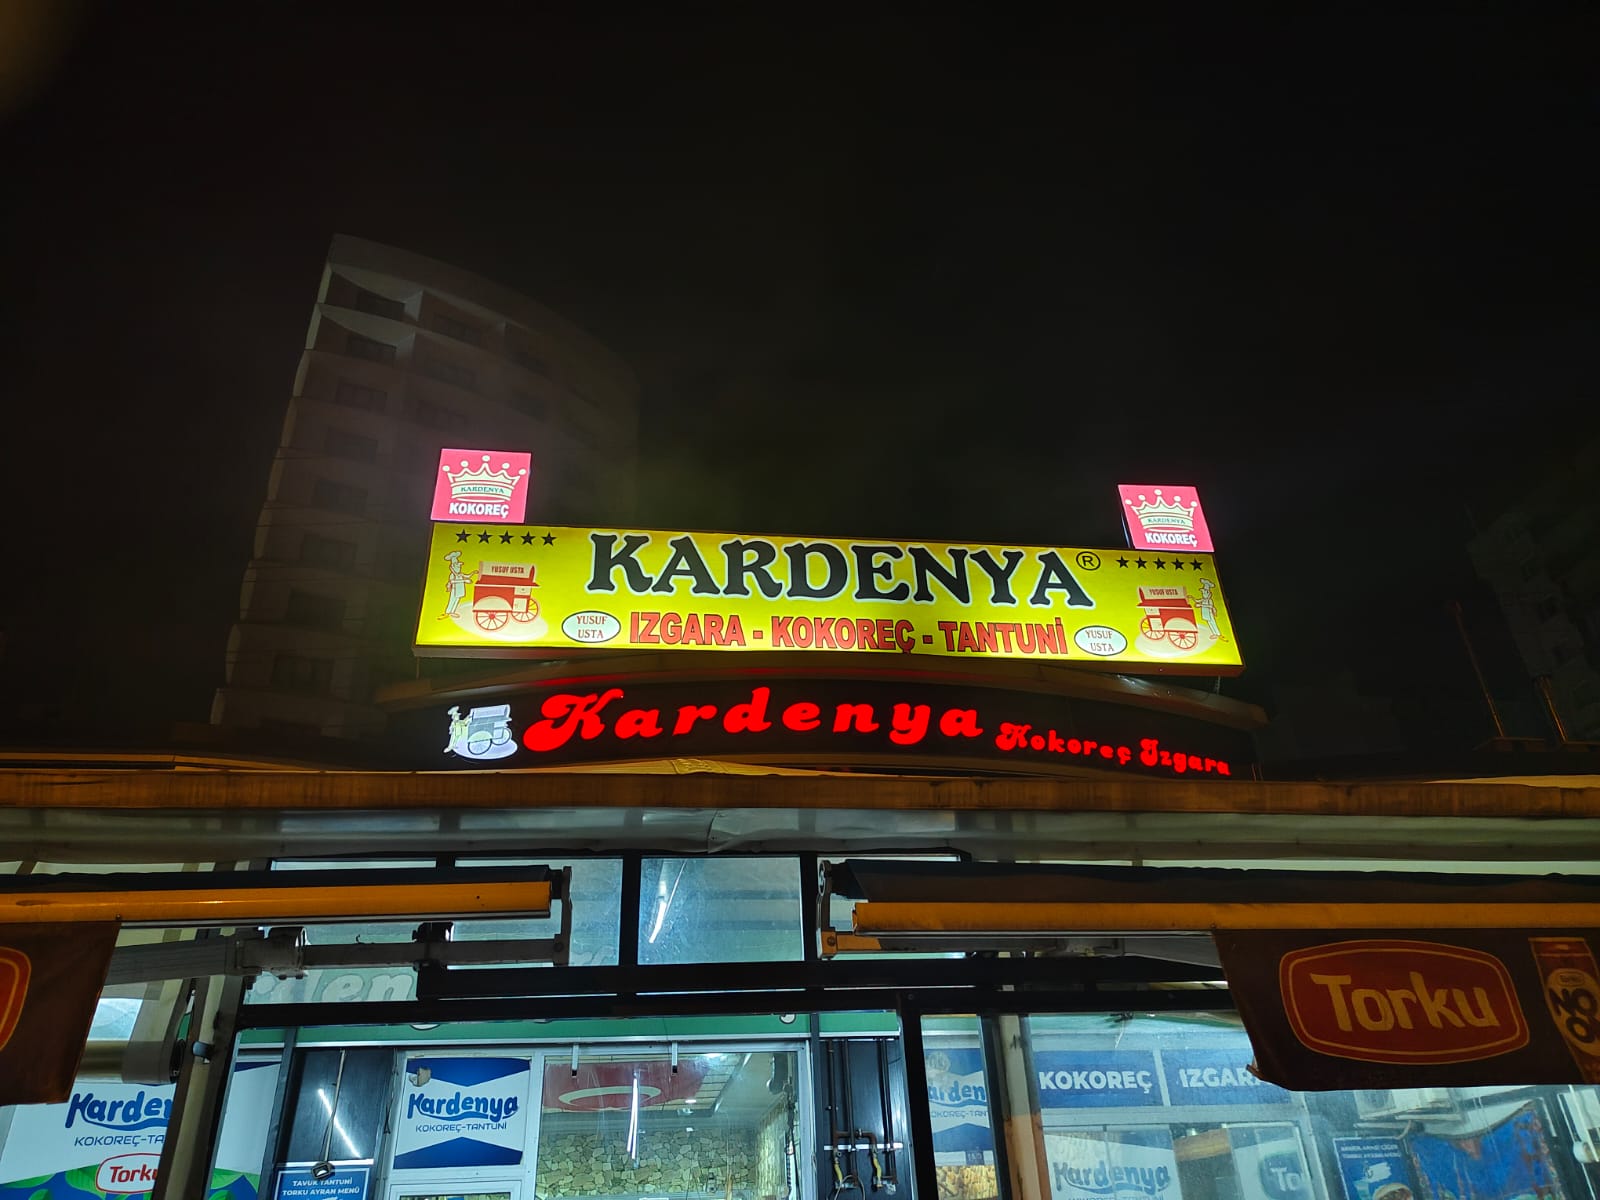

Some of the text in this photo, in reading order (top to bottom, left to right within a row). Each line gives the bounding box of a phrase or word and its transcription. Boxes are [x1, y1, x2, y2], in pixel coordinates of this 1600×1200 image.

[449, 502, 510, 519] KOKOREÇ
[1147, 517, 1186, 525] KARDENYA
[1145, 532, 1198, 547] KOKOREÇ
[510, 565, 525, 574] USTA
[588, 531, 1095, 608] KARDENYA
[576, 615, 608, 625] YUSUF
[577, 629, 605, 639] USTA
[630, 612, 746, 646] IZGARA
[771, 616, 916, 654] KOKOREÇ
[938, 617, 1068, 654] TANTUNİ
[1084, 629, 1113, 640] YUSUF
[1090, 643, 1115, 653] USTA
[522, 686, 984, 753] Kardenya
[995, 722, 1131, 765] Kokoreç
[1309, 971, 1500, 1032] Torku
[1038, 1069, 1153, 1094] KOKOREÇ
[1179, 1067, 1261, 1088] IZGAR
[407, 1092, 518, 1122] Kardenya
[416, 1122, 507, 1133] KOKOREÇ-TANTUNİ
[320, 1177, 353, 1186] TANTUNİ
[1053, 1160, 1171, 1195] Kardenya
[282, 1186, 361, 1196] TORKU AYRAN MENÜ
